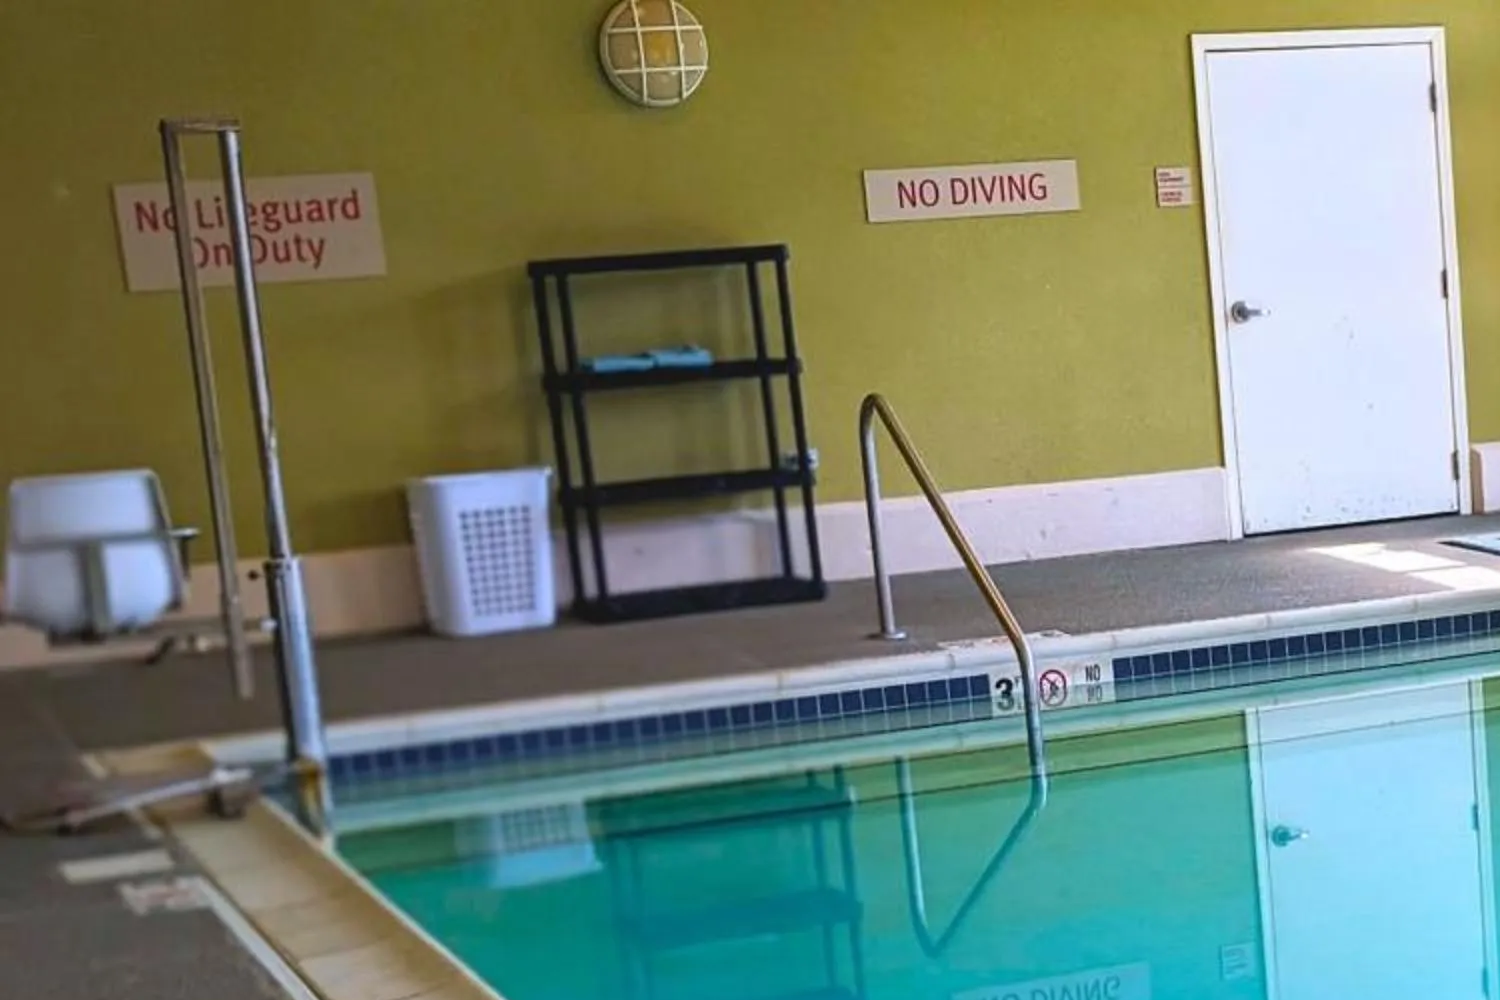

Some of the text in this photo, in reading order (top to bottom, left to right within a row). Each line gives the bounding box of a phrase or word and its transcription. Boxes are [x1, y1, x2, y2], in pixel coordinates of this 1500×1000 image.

[896, 172, 1048, 209] NO DIVING
[194, 188, 362, 234] Lieguard
[1085, 663, 1101, 682] NO
